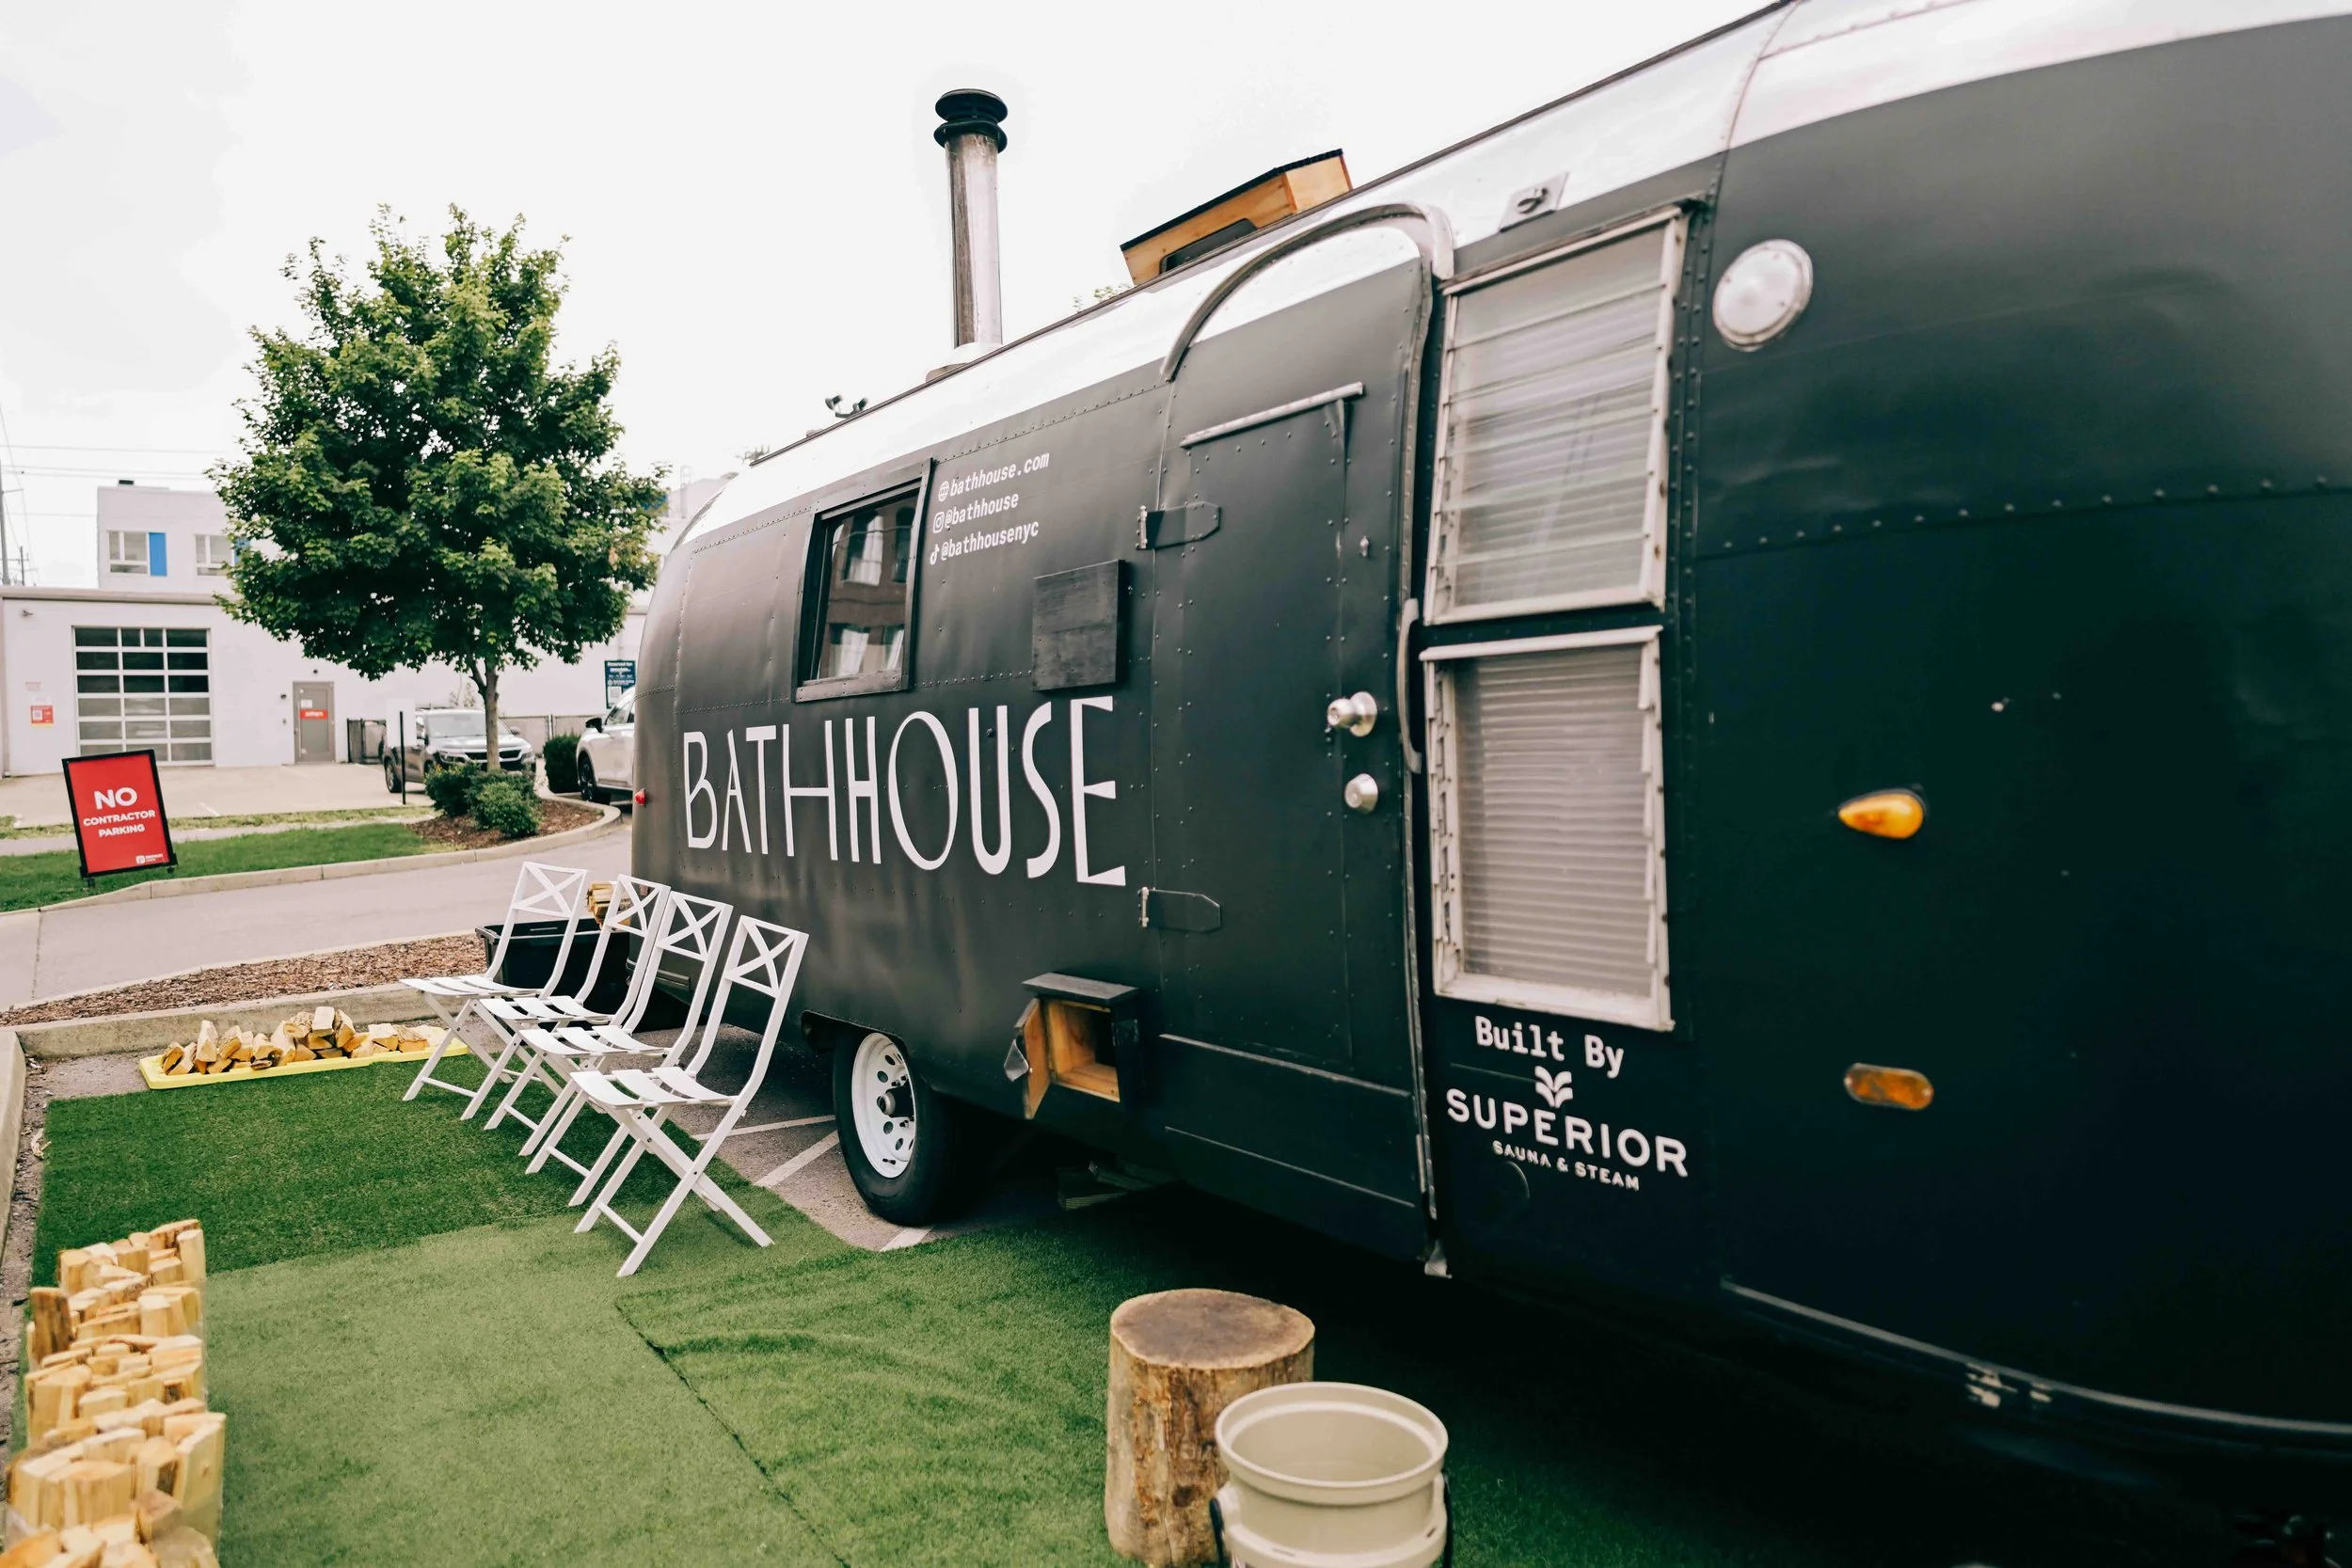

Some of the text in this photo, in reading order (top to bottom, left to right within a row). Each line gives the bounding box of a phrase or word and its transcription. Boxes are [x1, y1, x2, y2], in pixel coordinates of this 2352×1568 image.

[949, 451, 1050, 497] bathhouse.com
[944, 492, 1019, 529] @bathhouse
[941, 520, 1040, 561] @bathhousenyc
[94, 787, 137, 810] NO
[683, 695, 1126, 887] BATHHOUSE
[83, 810, 155, 827] CONTRACTOR
[98, 823, 145, 838] PARKING
[1474, 1015, 1625, 1079] Built By
[1445, 1087, 1689, 1178] SUPERIOR
[1491, 1139, 1641, 1192] SAUNA & STEAM
